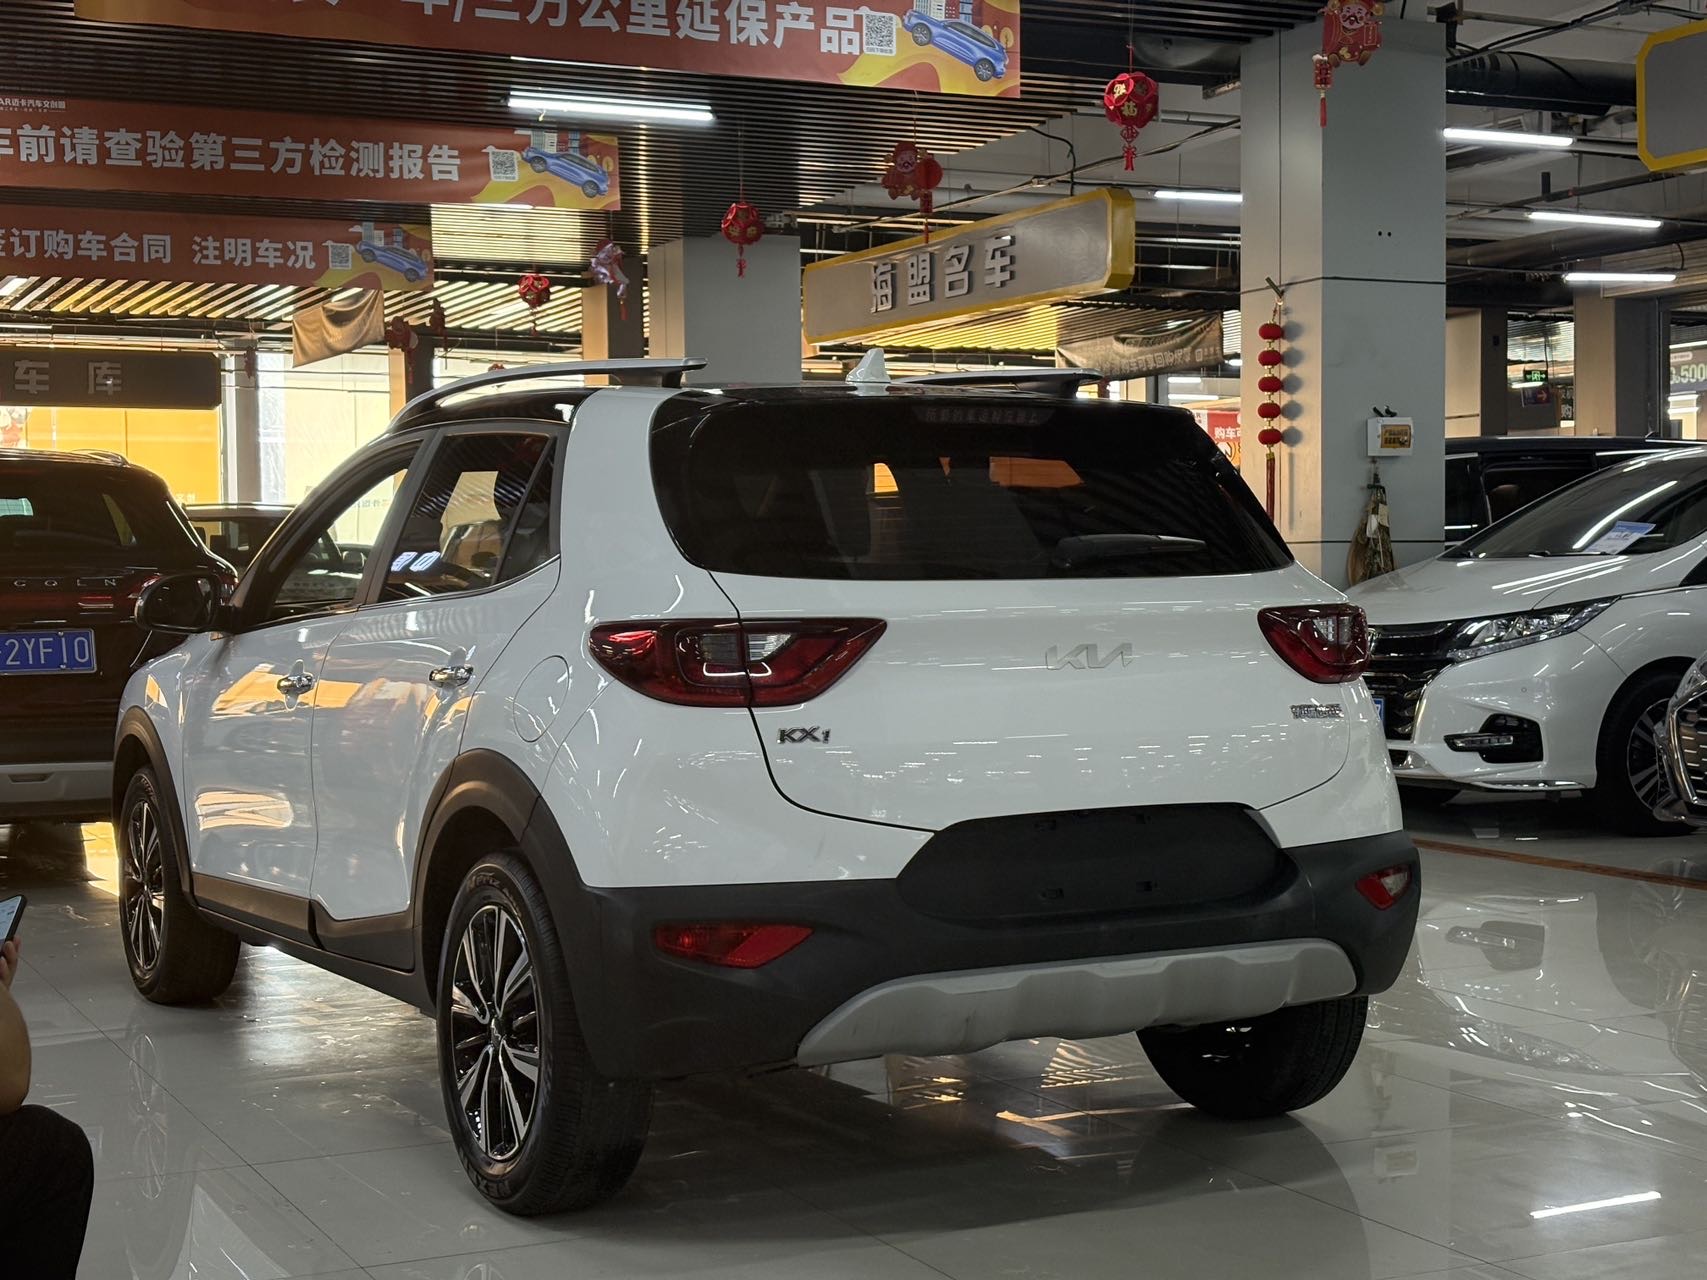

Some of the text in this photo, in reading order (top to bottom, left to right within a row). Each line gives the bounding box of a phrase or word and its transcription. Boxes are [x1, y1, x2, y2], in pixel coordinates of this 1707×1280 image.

[0, 227, 316, 270] 订购车合同 注明车况
[5, 637, 90, 666] 2YF10
[776, 726, 831, 744] KX1
